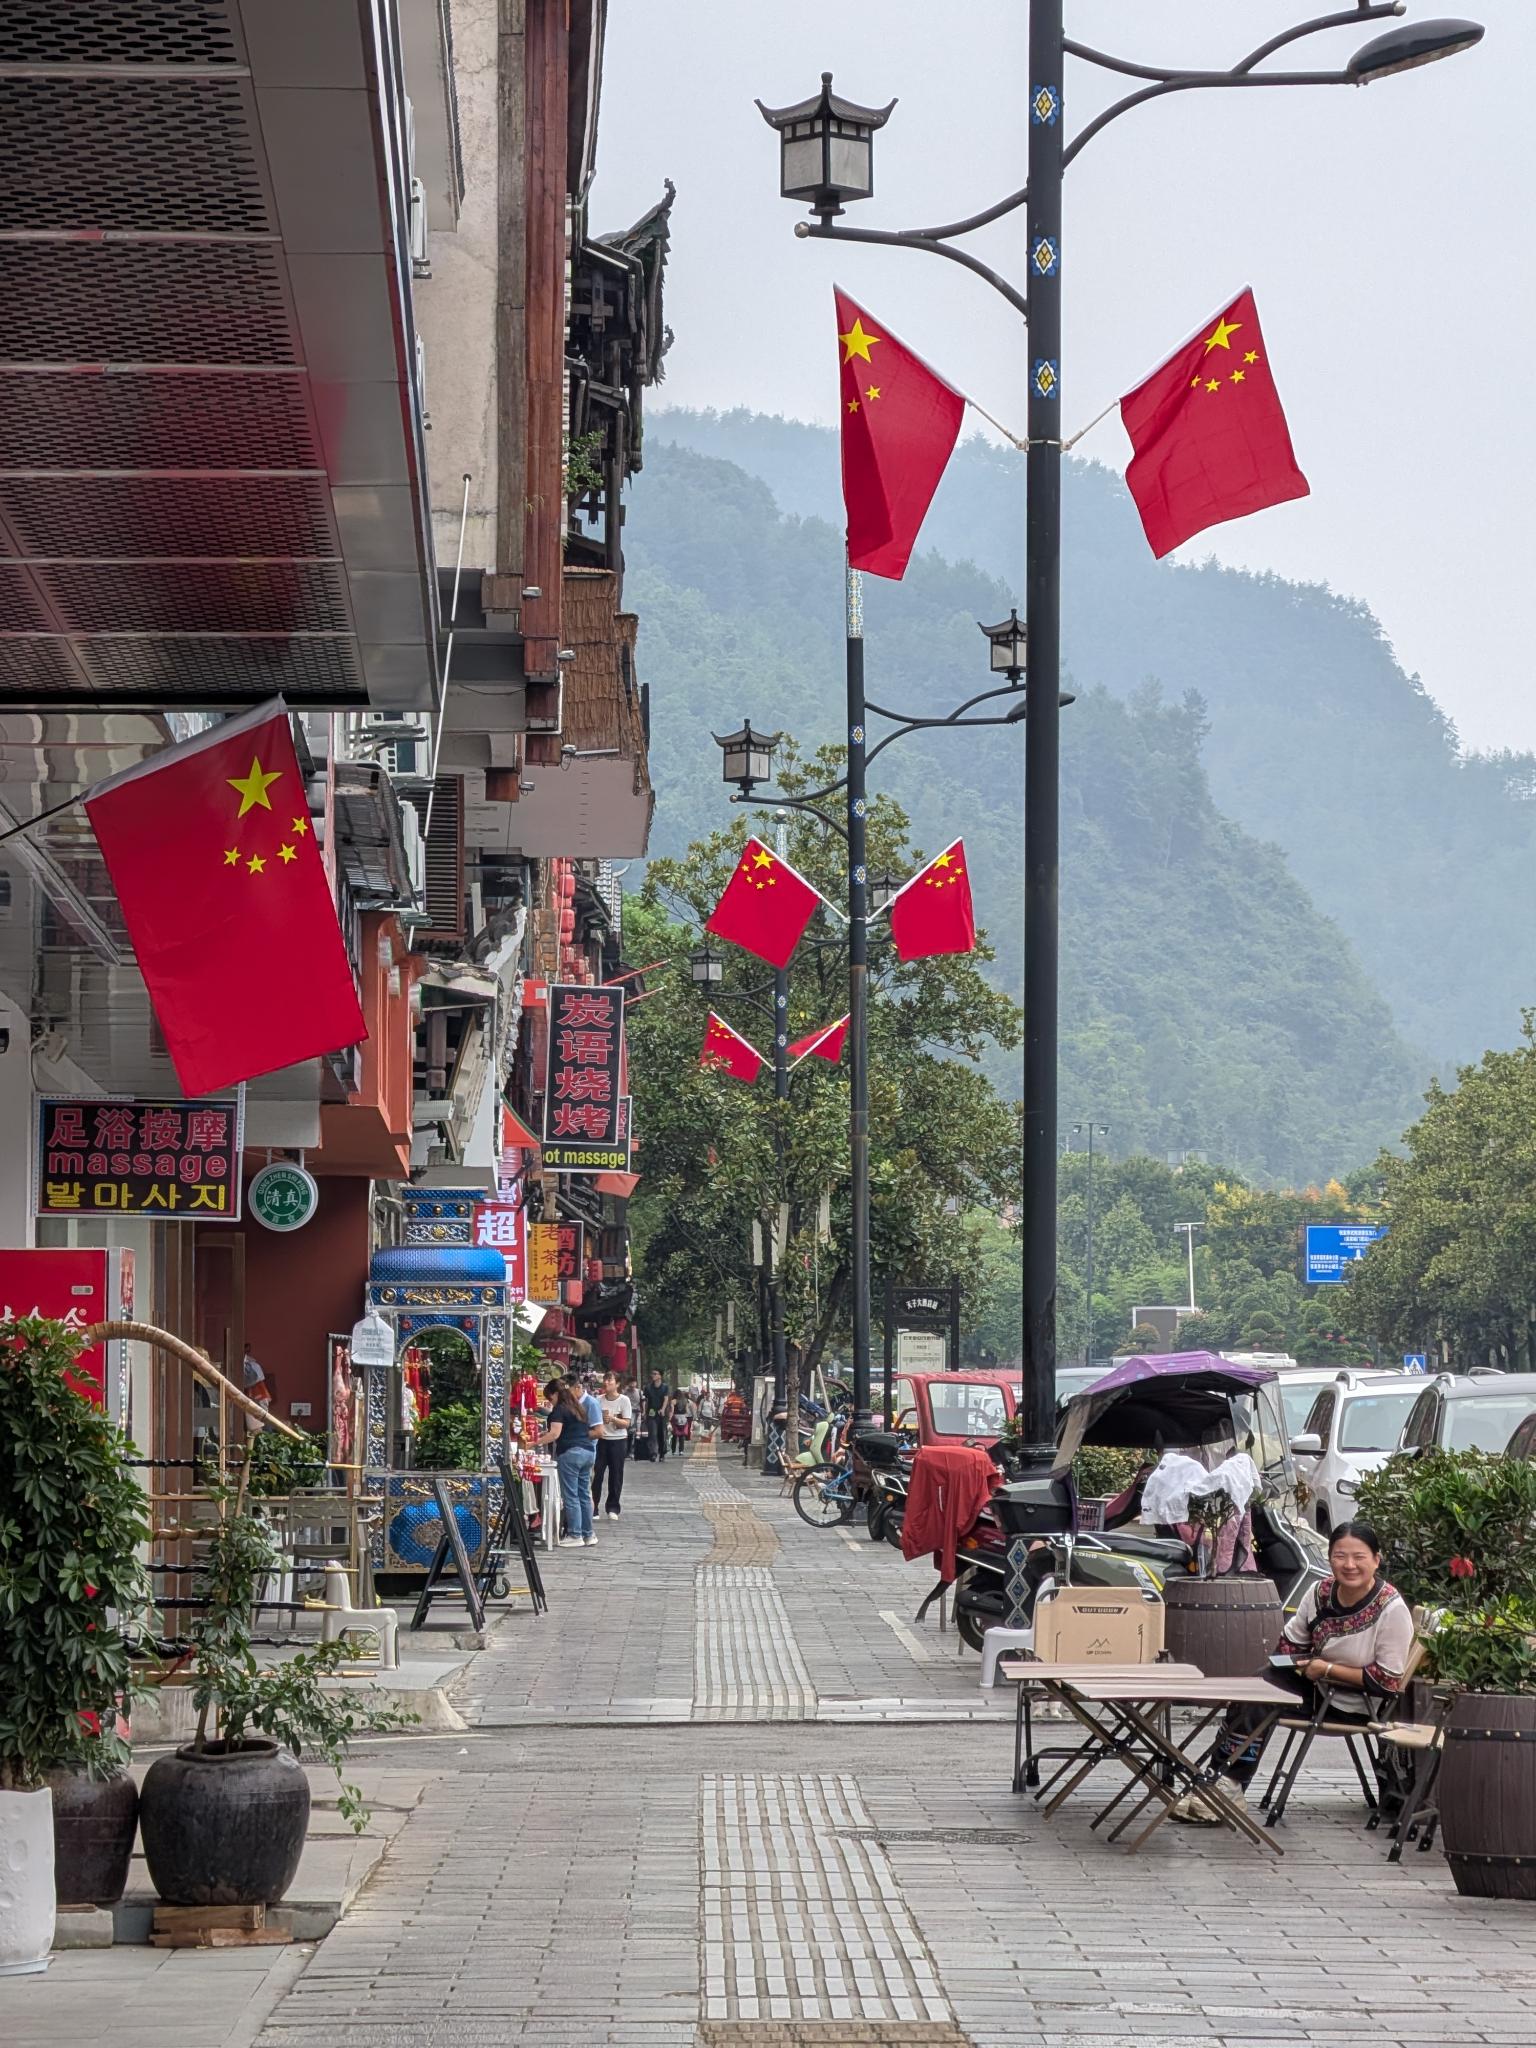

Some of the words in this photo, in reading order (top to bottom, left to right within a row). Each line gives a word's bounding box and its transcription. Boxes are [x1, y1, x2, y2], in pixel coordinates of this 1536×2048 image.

[553, 994, 615, 1138] 炭语烧烤
[47, 1108, 227, 1152] 足浴按摩
[48, 1152, 227, 1183] massage
[564, 1151, 626, 1169] massage
[46, 1181, 226, 1211] 발마사지
[266, 1188, 298, 1207] 清真
[541, 1223, 559, 1292] 老茶馆
